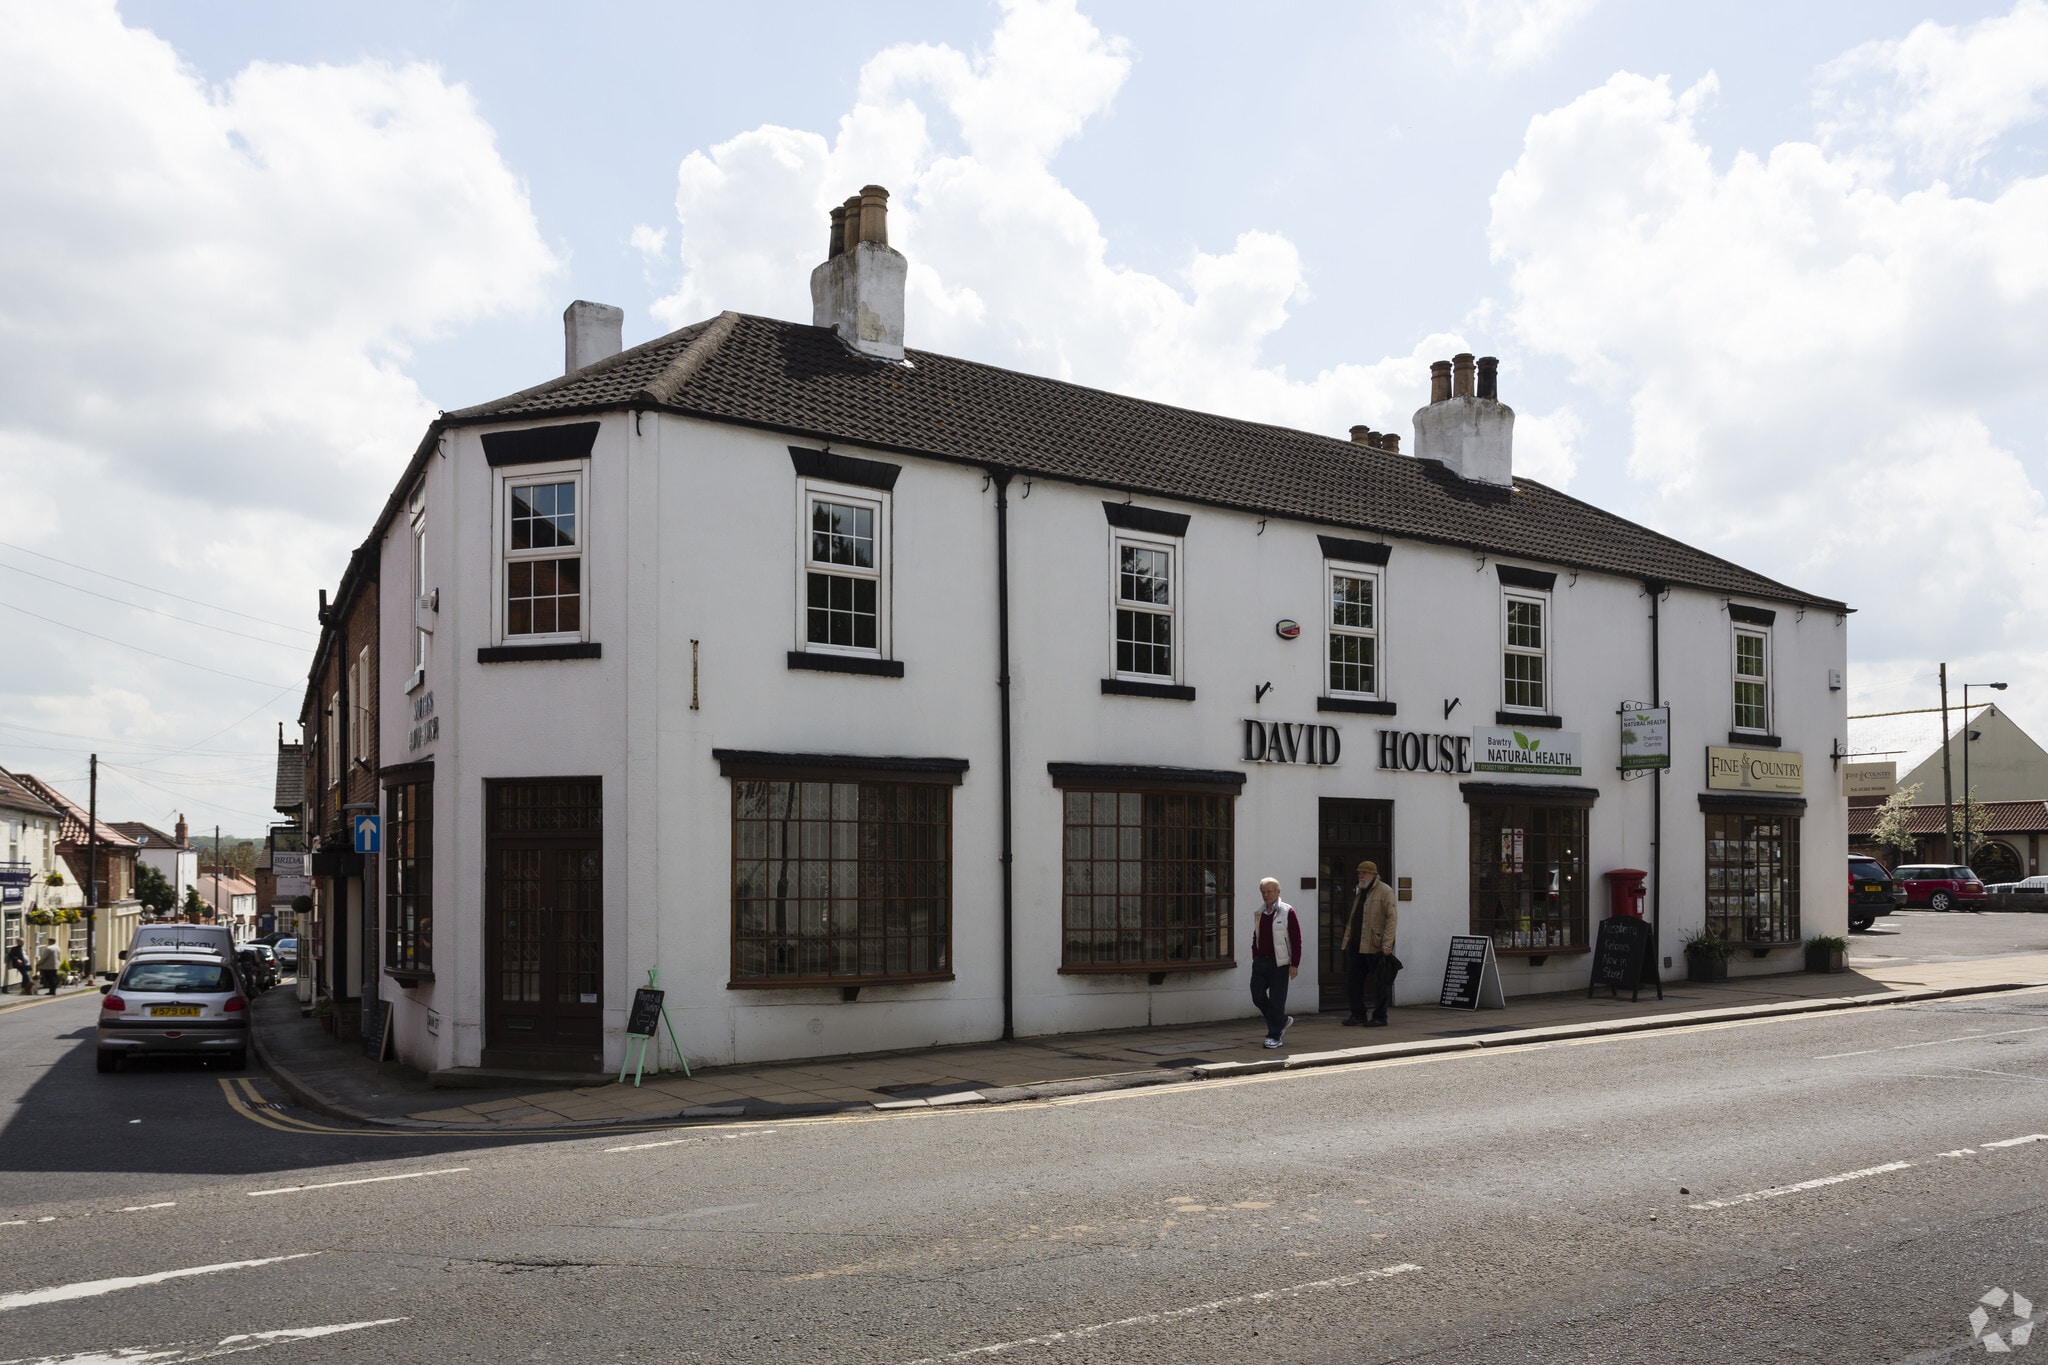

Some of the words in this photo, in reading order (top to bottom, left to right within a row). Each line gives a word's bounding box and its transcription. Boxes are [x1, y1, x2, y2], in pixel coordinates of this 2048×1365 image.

[1244, 718, 1341, 765] DAVID
[1379, 730, 1472, 774] HOUSE
[1487, 736, 1512, 748] Bawtry
[1488, 748, 1533, 763] NATURAL
[1535, 751, 1572, 765] HEALTH
[1711, 757, 1739, 777] FINE
[1742, 752, 1750, 765] &
[1751, 759, 1802, 780] COUNTRY
[1603, 921, 1638, 936] Raspberry
